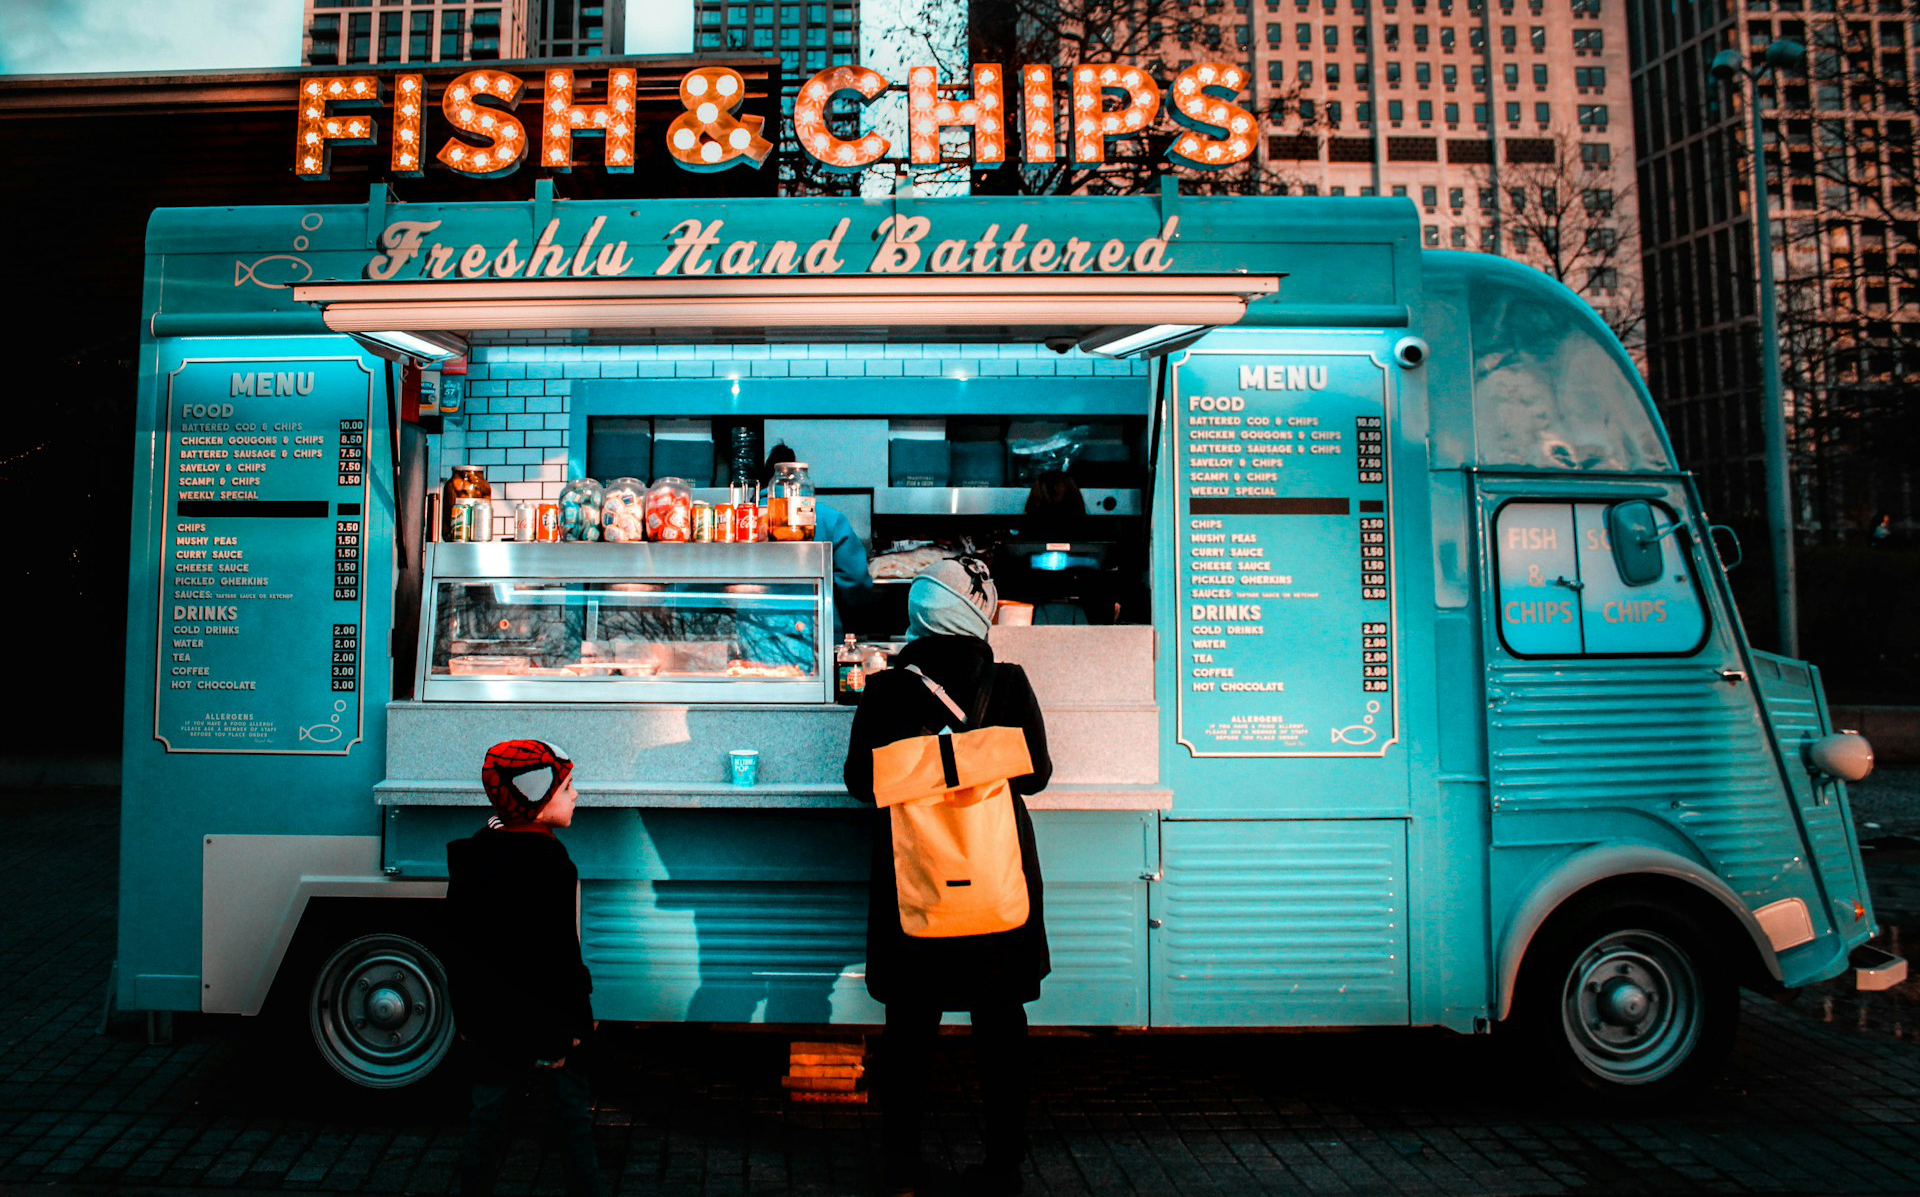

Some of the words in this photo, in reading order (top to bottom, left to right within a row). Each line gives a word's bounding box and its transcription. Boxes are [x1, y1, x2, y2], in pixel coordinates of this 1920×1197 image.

[296, 68, 637, 180] FISH
[666, 66, 773, 171] &
[794, 62, 1258, 171] CHIPS
[655, 217, 851, 275] Hand
[867, 213, 1179, 274] Battered
[1240, 365, 1327, 389] MENU
[232, 371, 314, 395] MENU
[1190, 396, 1245, 411] FOOD
[183, 403, 234, 417] FOOD
[341, 421, 362, 429] 10.00
[1190, 417, 1242, 425] BATTERED
[1288, 417, 1318, 426] CHIPS
[1358, 418, 1380, 427] 10.00
[181, 423, 229, 431] BATTERED
[236, 423, 256, 431] COD
[341, 435, 362, 444] 8.50
[1190, 431, 1235, 439] CHICKEN
[1311, 431, 1341, 439] CHIPS
[182, 437, 223, 445] CHICKEN
[228, 436, 277, 444] GOUGONS
[341, 449, 360, 457] 7.50
[1190, 444, 1242, 453] BATTERED
[1247, 445, 1292, 453] SAUSAGE
[1310, 445, 1341, 453] CHIPS
[1360, 445, 1381, 454] 7.50
[181, 450, 228, 458] BATTERED
[294, 449, 322, 457] CHIPS
[180, 463, 220, 471] SAVELOY
[238, 463, 266, 471] CHIPS
[340, 463, 360, 471] 7.50
[1191, 458, 1234, 467] SAVELOY
[1252, 458, 1283, 467] CHIPS
[1359, 459, 1381, 467] 7.50
[180, 477, 214, 485] SCAMPI
[232, 477, 260, 485] CHIPS
[339, 476, 360, 485] 8.50
[1191, 472, 1229, 481] SCAMPI
[1247, 473, 1277, 481] CHIPS
[179, 491, 214, 499] WEEKLY
[220, 491, 258, 499] SPECIAL
[1191, 487, 1229, 495] WEEKLY
[1236, 487, 1276, 495] SPECIAL
[177, 523, 205, 531] CHIPS
[338, 523, 360, 533] 3.50
[1191, 519, 1222, 529] CHIPS
[177, 537, 208, 545] MUSHY
[214, 537, 237, 545] PEAS
[338, 536, 356, 544] 1.50
[1191, 533, 1226, 542] MUSHY
[1232, 533, 1257, 543] PEAS
[1363, 533, 1383, 542] 1.50
[1508, 528, 1557, 550] FISH
[176, 551, 207, 559] CURRY
[338, 549, 356, 557] 1.50
[1192, 547, 1225, 556] CURRY
[1231, 547, 1264, 557] SAUCE
[1364, 547, 1383, 556] 1.50
[219, 564, 248, 572] SAUCE
[337, 563, 355, 571] 1.50
[1192, 561, 1232, 570] CHEESE
[1238, 561, 1271, 570] SAUCE
[1364, 561, 1384, 570] 1.50
[337, 576, 355, 584] 1.00
[1192, 575, 1236, 584] PICKLED
[1241, 575, 1292, 584] GHERKINS
[1365, 575, 1384, 584] 1.00
[1527, 564, 1545, 587] &
[175, 577, 215, 585] PICKLED
[221, 577, 268, 585] GHERKINS
[335, 589, 355, 598] 0.50
[1364, 589, 1386, 598] 0.50
[174, 606, 237, 620] DRINKS
[1192, 605, 1262, 620] DRINKS
[1505, 600, 1573, 623] CHIPS
[1603, 600, 1667, 623] CHIPS
[206, 626, 239, 634] DRINKS
[334, 626, 355, 635] 2.00
[1193, 625, 1222, 635] COLD
[1227, 625, 1264, 634] DRINKS
[1364, 624, 1386, 634] 2.00
[174, 639, 203, 647] WATER
[335, 640, 355, 648] 2.00
[1193, 639, 1226, 648] WATER
[1365, 638, 1386, 647] 2.00
[173, 653, 190, 661] TEA
[334, 653, 354, 662] 2.00
[1193, 653, 1213, 663] TEA
[1365, 653, 1388, 662] 2.00
[172, 667, 209, 675] COFFEE
[333, 667, 353, 675] 3.00
[1193, 668, 1234, 677] COFFEE
[197, 681, 256, 689] CHOCOLATE
[333, 681, 353, 689] 3.00
[1193, 682, 1215, 691] HOT
[1221, 682, 1284, 691] CHOCOLATE
